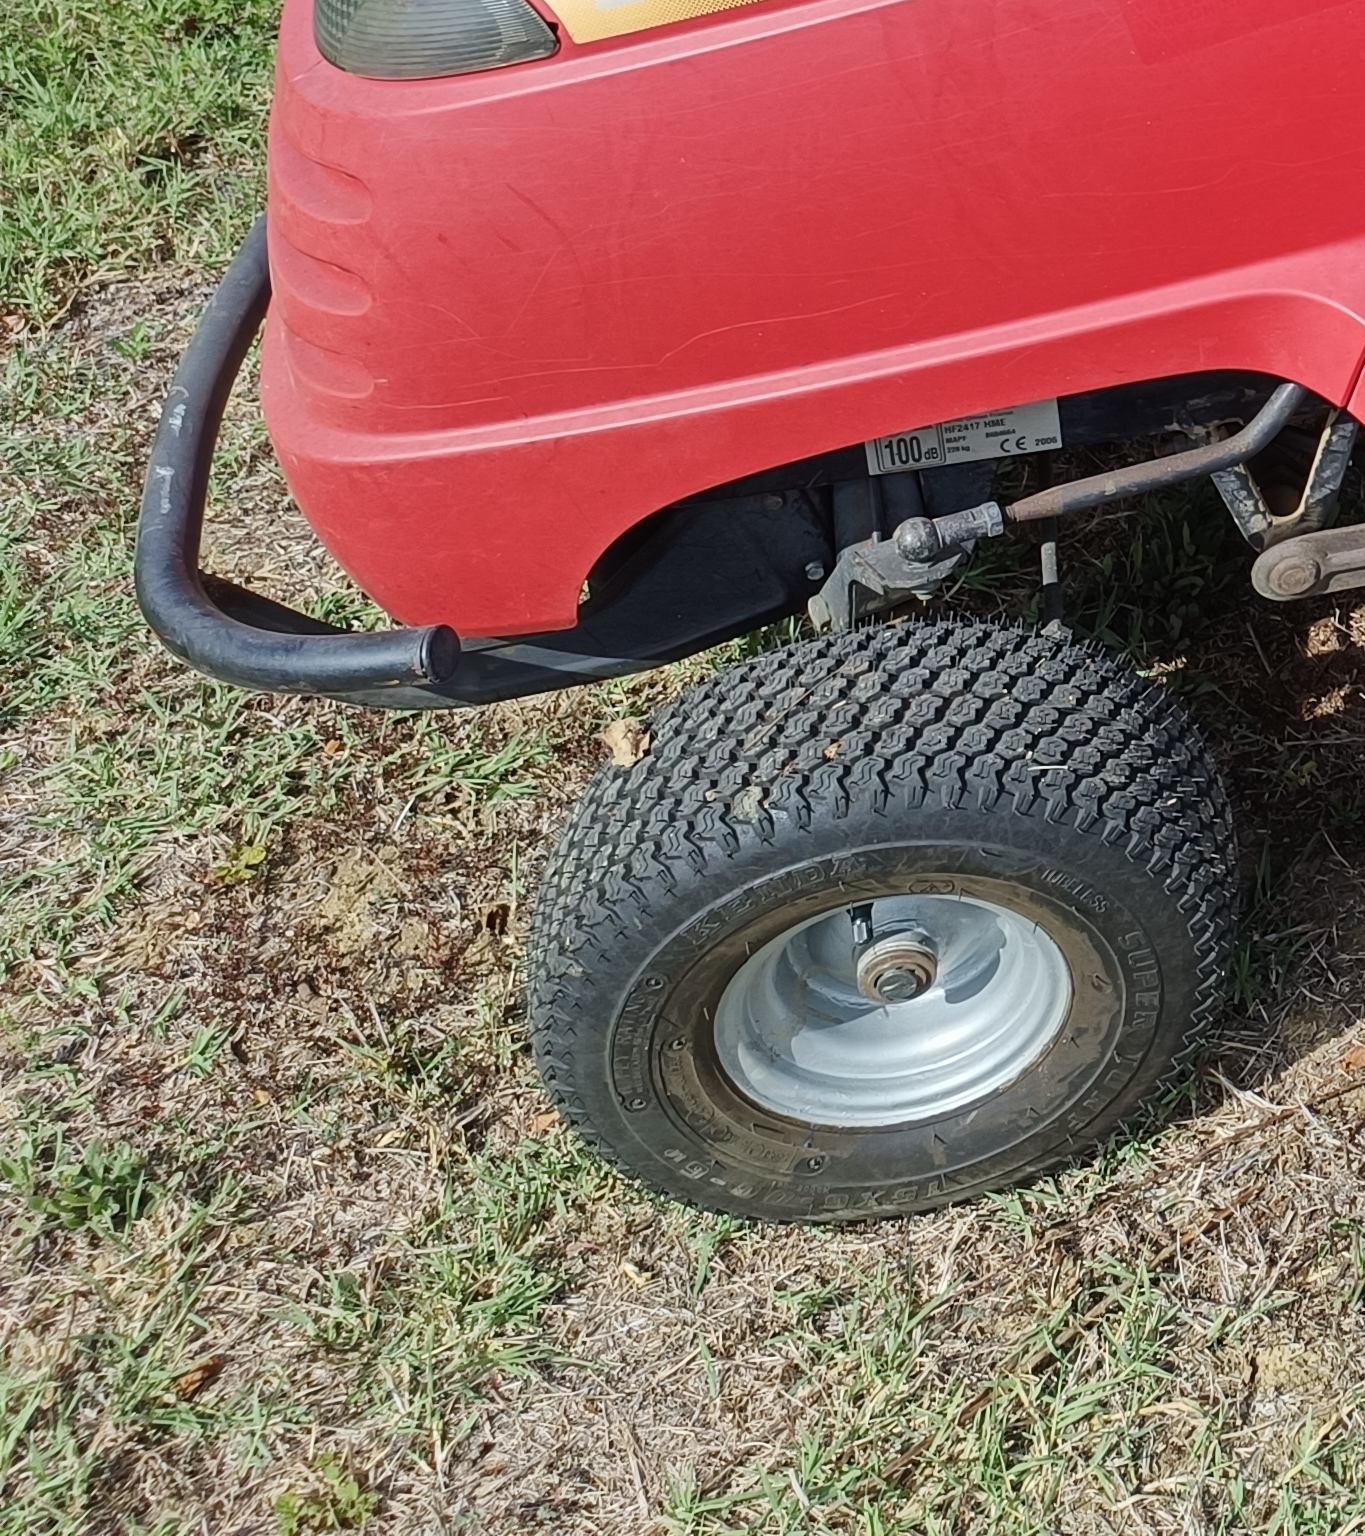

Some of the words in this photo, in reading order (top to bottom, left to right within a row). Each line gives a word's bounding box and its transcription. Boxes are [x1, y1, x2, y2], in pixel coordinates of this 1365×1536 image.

[884, 436, 922, 465] 100
[924, 447, 939, 460] dB
[680, 856, 868, 945] KENDA
[1041, 868, 1110, 913] TUBELESS
[1117, 931, 1160, 1029] SUPER
